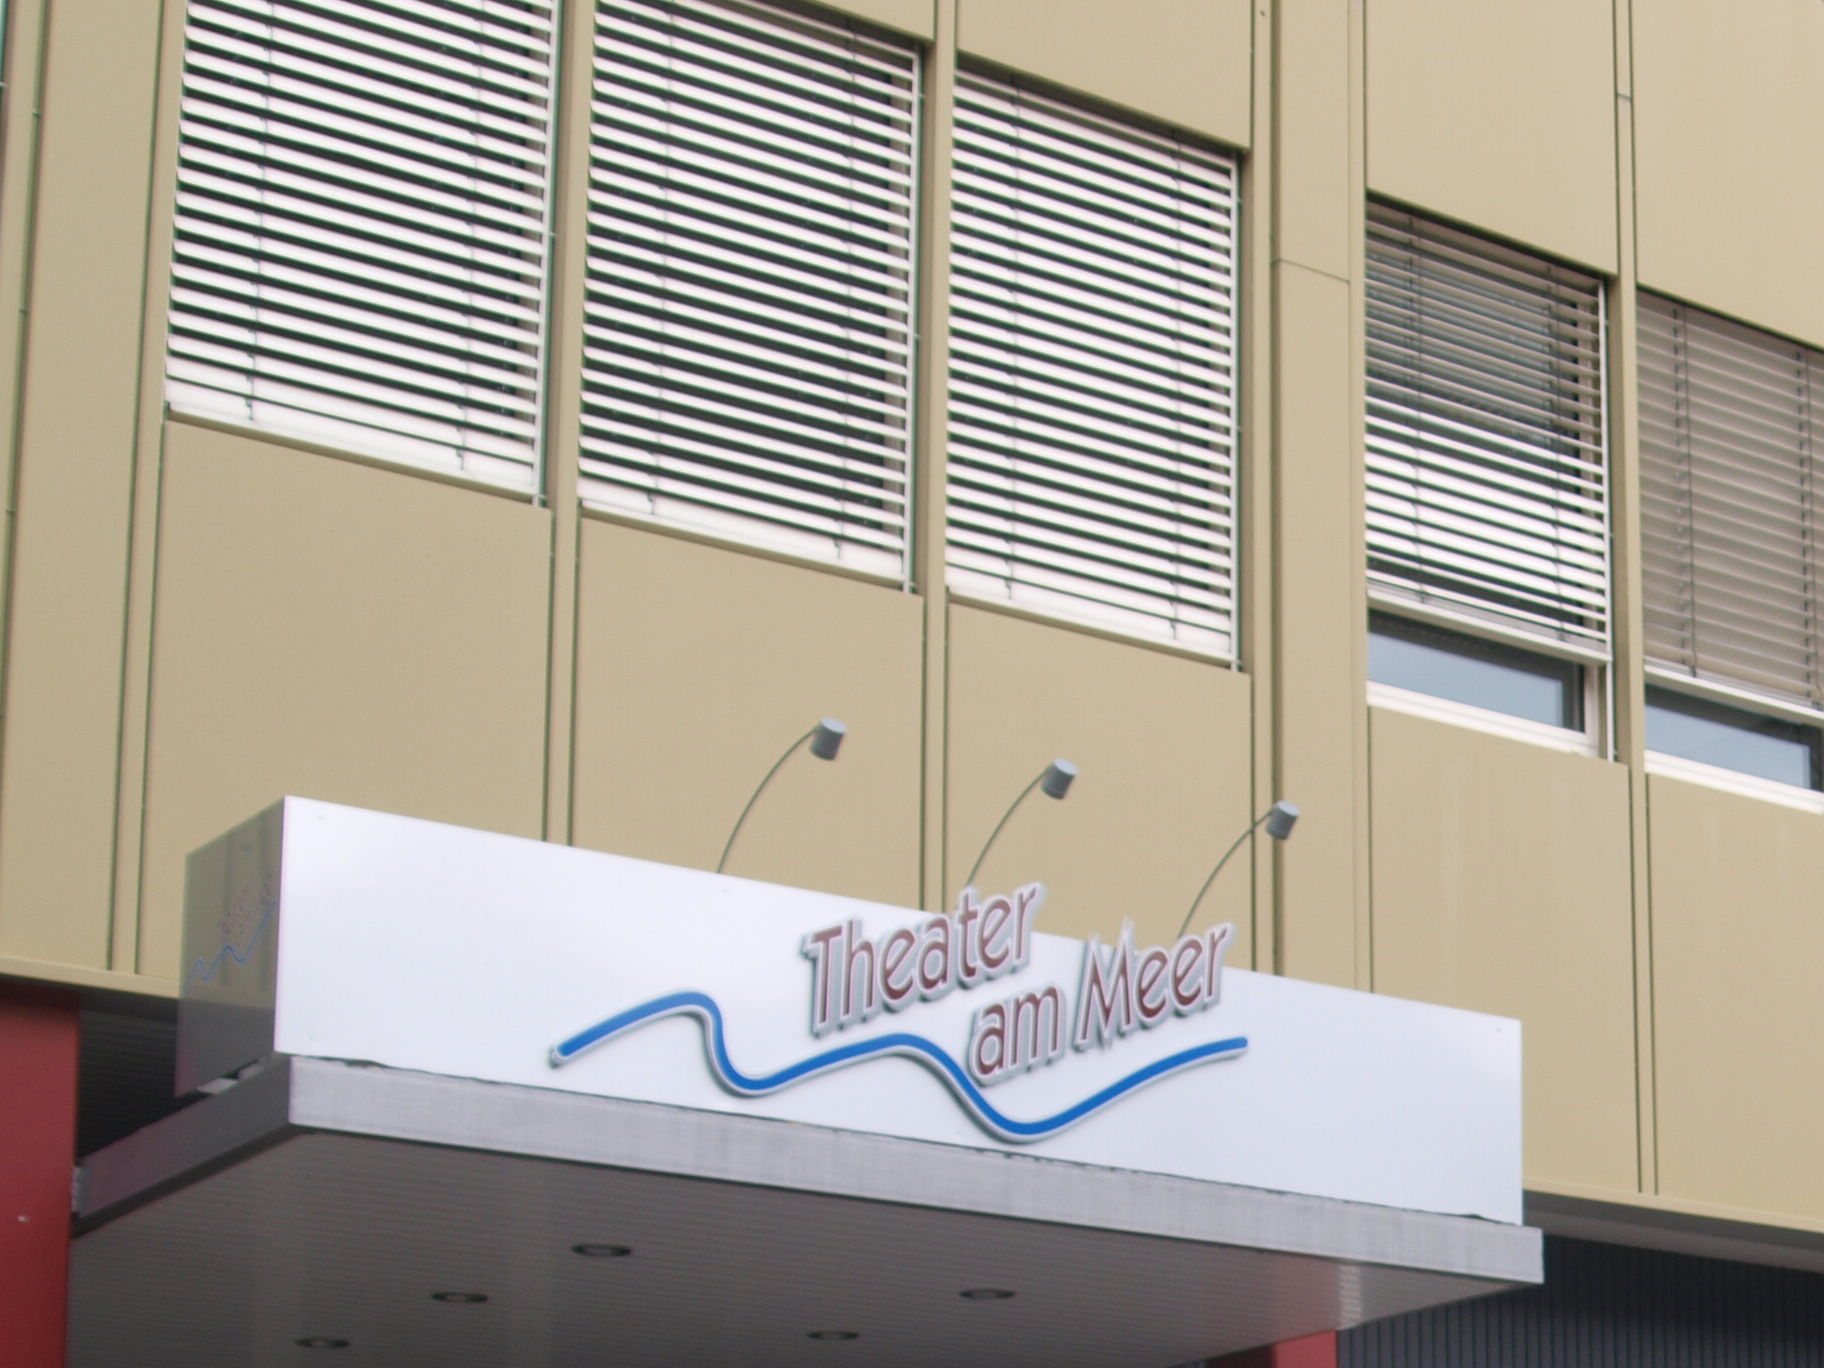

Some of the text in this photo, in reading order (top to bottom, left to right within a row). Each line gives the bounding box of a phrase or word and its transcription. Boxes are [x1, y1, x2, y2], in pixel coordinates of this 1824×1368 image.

[803, 882, 1044, 1037] Theater
[968, 917, 1236, 1087] am Meer
